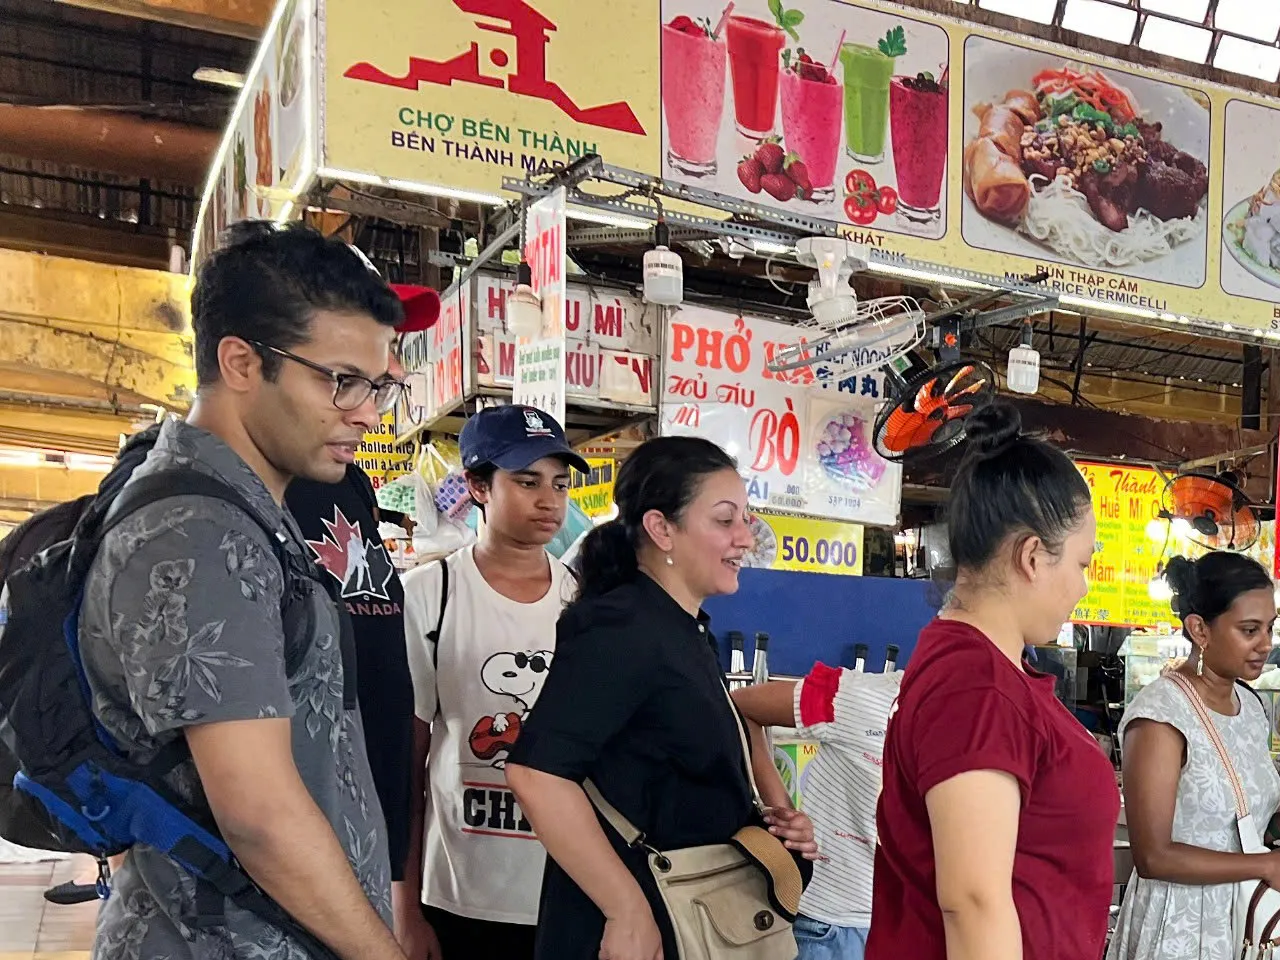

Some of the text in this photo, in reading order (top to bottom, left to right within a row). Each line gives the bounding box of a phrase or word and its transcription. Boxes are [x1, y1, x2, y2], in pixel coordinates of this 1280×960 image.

[398, 107, 597, 157] CHỢ BẾN THÀNH
[391, 130, 435, 153] BẾN
[442, 140, 514, 167] THÀNH
[842, 229, 885, 246] KHÁT
[1036, 263, 1065, 280] BÚN
[1052, 280, 1084, 296] RICE
[1086, 286, 1167, 311] VERMICELLI
[594, 299, 623, 338] MÌ
[671, 318, 753, 373] PHỞ
[361, 440, 393, 454] Rolled
[750, 397, 800, 476] BÒ
[1110, 469, 1159, 496] Thành
[782, 535, 858, 568] 50.000
[344, 602, 401, 616] ANADA
